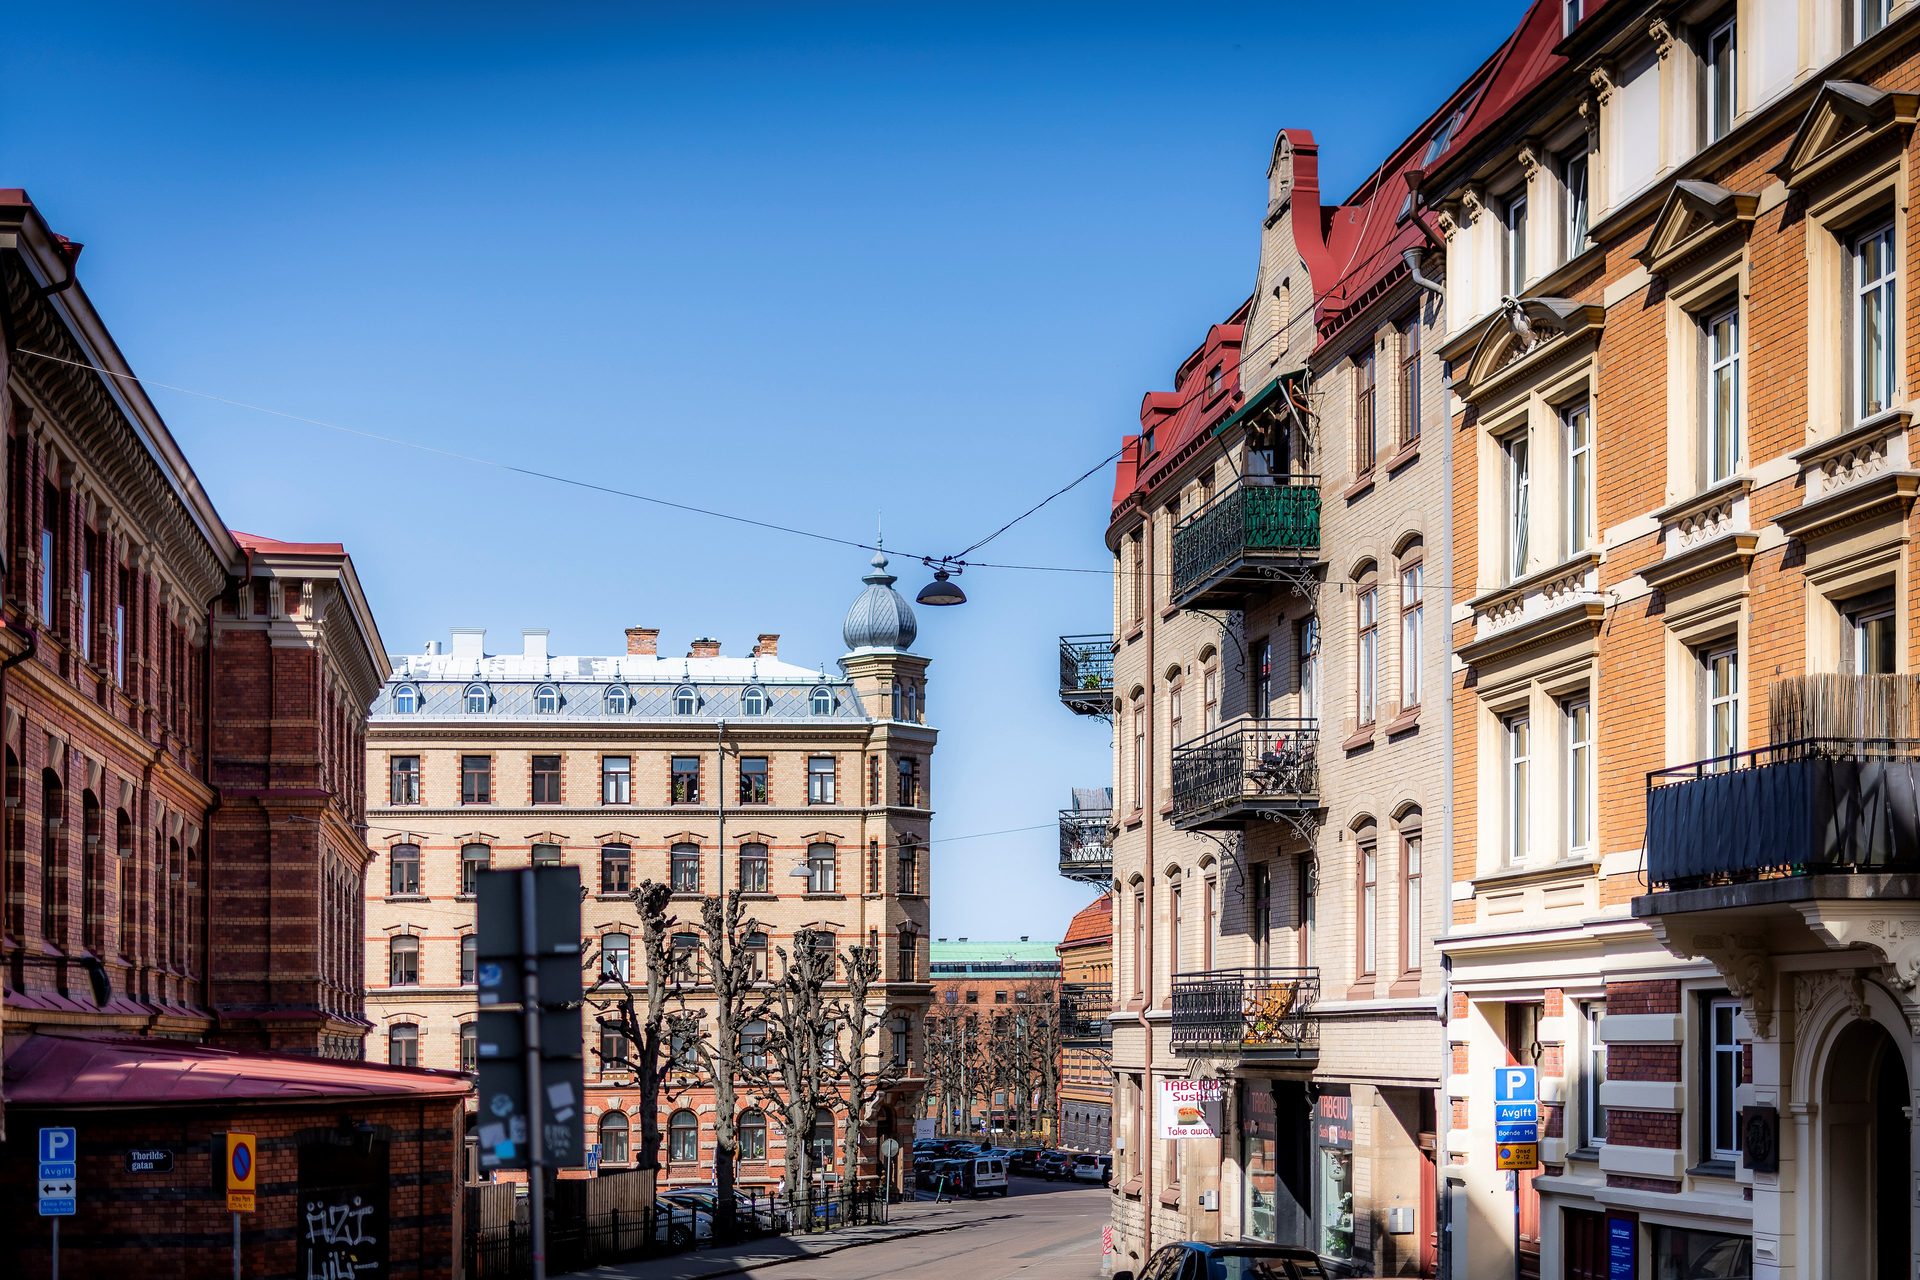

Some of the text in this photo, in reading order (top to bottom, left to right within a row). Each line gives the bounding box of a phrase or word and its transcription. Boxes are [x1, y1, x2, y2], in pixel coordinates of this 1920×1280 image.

[1507, 1071, 1526, 1099] P
[1502, 1109, 1532, 1119] Avgift
[1168, 1127, 1214, 1136] Take away
[49, 1131, 69, 1159] P
[131, 1151, 167, 1160] Thorilds-
[44, 1167, 72, 1176] Avgift
[131, 1161, 154, 1172] gatan
